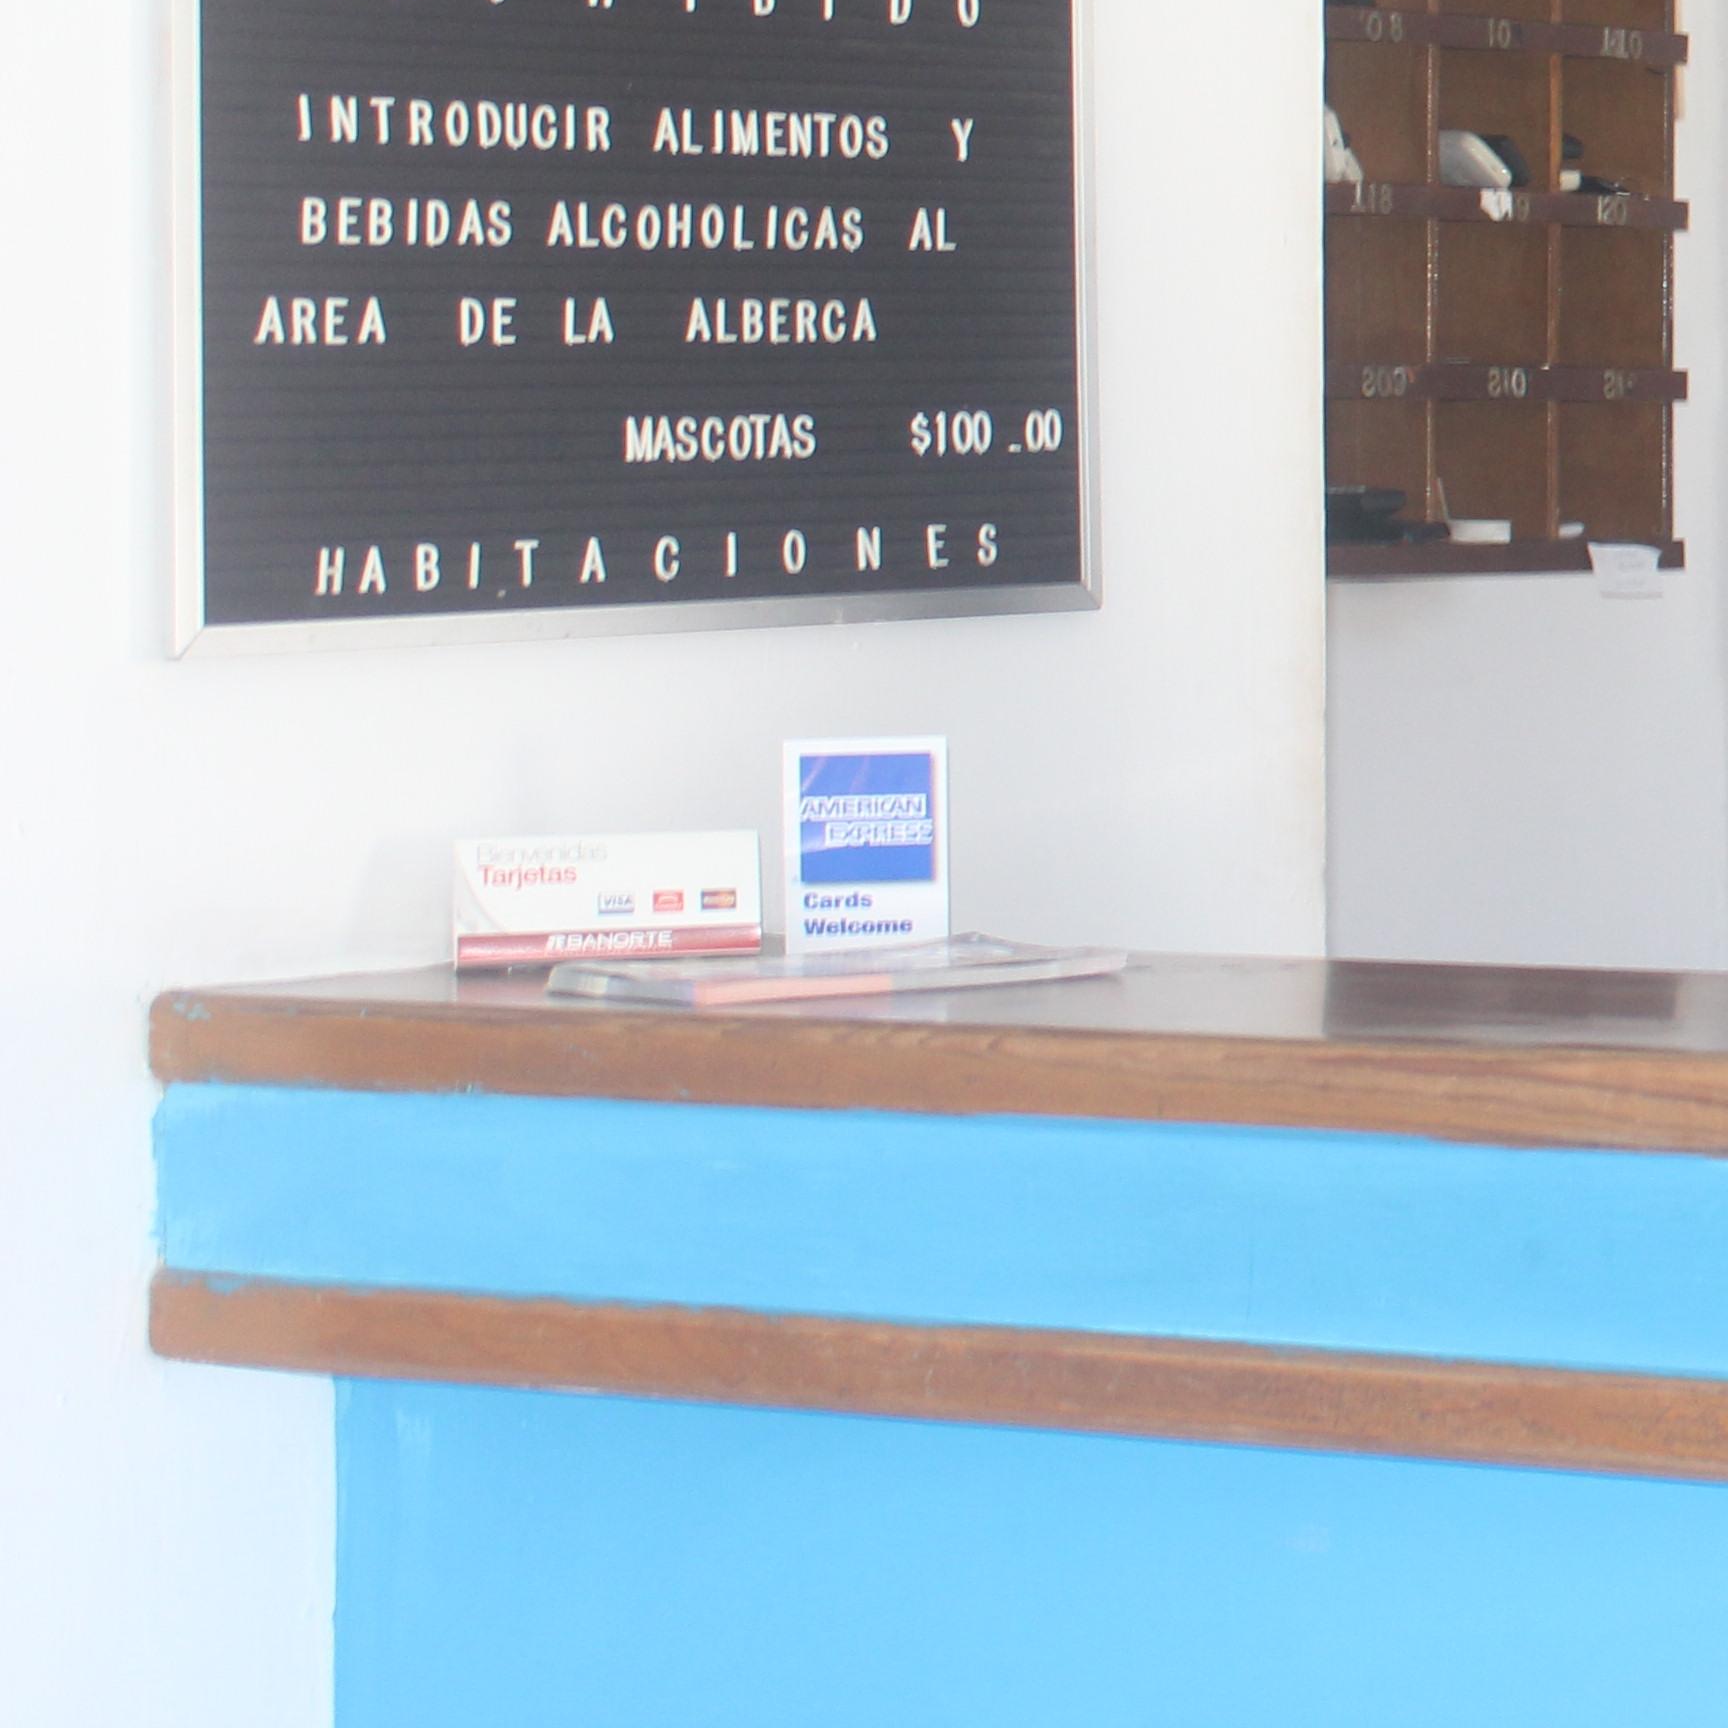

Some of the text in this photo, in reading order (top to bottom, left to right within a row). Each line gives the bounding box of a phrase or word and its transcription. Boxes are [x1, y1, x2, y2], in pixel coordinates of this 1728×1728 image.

[298, 93, 973, 162] INTRODUCIR ALIMENTOS Y
[301, 196, 956, 253] BEBIDAS ALCOHOLICAS AL
[253, 295, 877, 347] AREA DE LA ALBERCA
[625, 413, 816, 463] MASCOTAS
[315, 523, 997, 596] HABITACIONES
[800, 793, 928, 822] AMERICAN
[825, 819, 933, 847] EXPRESS
[480, 864, 578, 890] Tarjetas
[603, 896, 634, 908] VISA
[803, 891, 873, 909] Cards
[566, 929, 673, 951] BANORTE
[804, 917, 913, 935] Welcome
